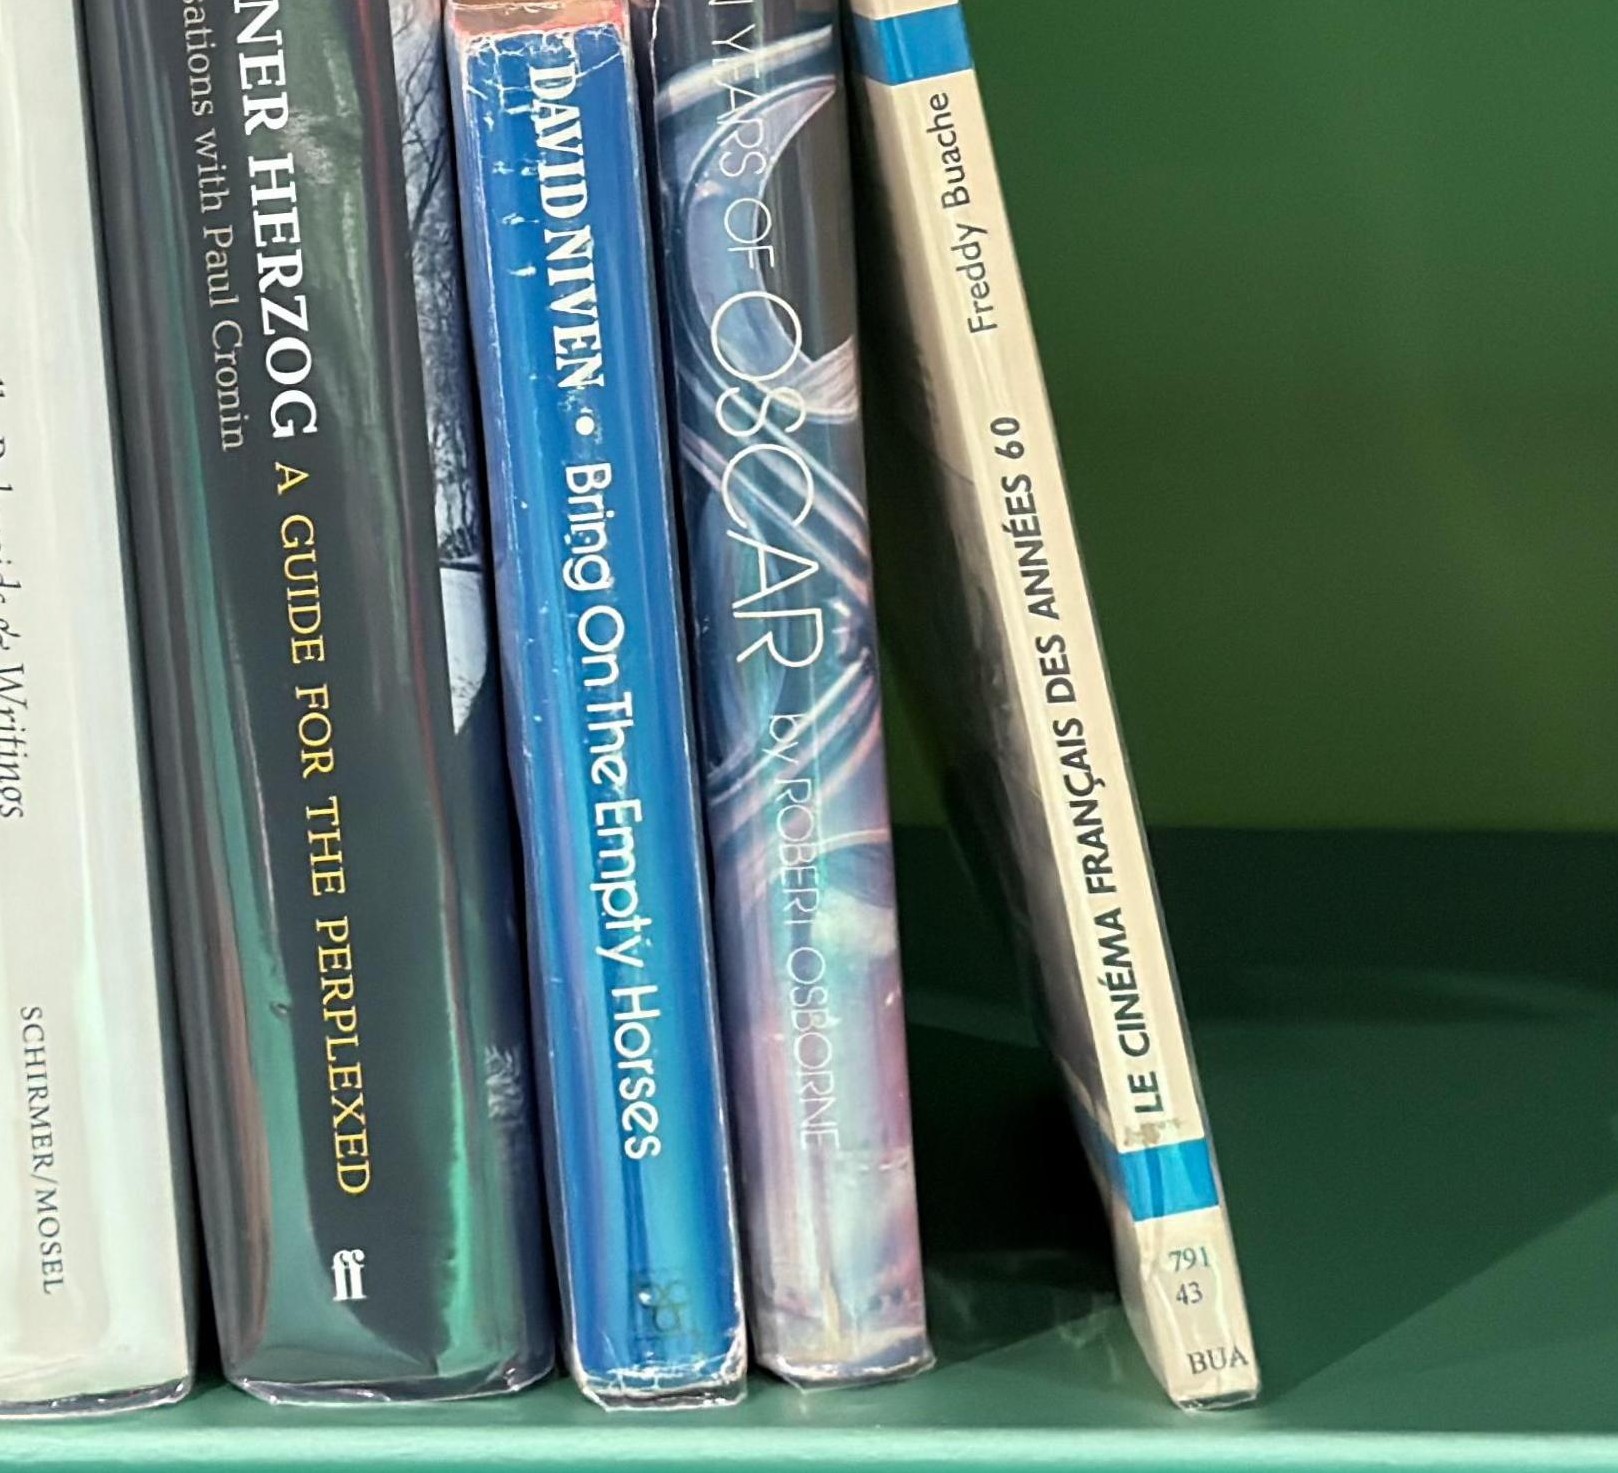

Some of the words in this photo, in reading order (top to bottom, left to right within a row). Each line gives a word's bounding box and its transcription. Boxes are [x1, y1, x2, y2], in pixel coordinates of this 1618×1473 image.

[528, 64, 588, 219] DAVID
[711, 24, 766, 177] YEARS
[927, 91, 971, 209] Buache
[194, 129, 227, 214] with
[202, 216, 241, 312] Paul
[724, 198, 774, 269] OF
[951, 224, 998, 335] Freddy
[248, 154, 319, 440] HERZOG
[542, 228, 605, 389] NIVEN
[208, 318, 251, 452] Cronin
[990, 416, 1025, 460] 60
[275, 461, 310, 496] A
[563, 462, 613, 592] Bring
[711, 291, 824, 668] OSCAR
[280, 513, 325, 665] GUIDE
[1002, 474, 1061, 620] ANNÉES
[577, 605, 625, 686] On
[1035, 635, 1076, 703] DES
[295, 684, 335, 780] FOR
[583, 692, 633, 786] The
[763, 714, 804, 767] by
[305, 796, 346, 896] THE
[774, 777, 821, 927] ROBERT
[1053, 717, 1117, 895] FRANÇAIS
[591, 799, 644, 969] Empty
[1093, 907, 1151, 1057] CINÉMA
[316, 916, 371, 1196] PERPLEXED
[611, 984, 661, 1161] Horses
[786, 946, 839, 1151] OSBORNE
[1128, 1071, 1164, 1115] LE
[20, 1006, 66, 1295] SCHIRMER/MOSEL
[331, 1249, 368, 1302] ff
[1168, 1246, 1211, 1273] 791
[1175, 1281, 1203, 1306] 43
[1187, 1346, 1249, 1376] BUA
